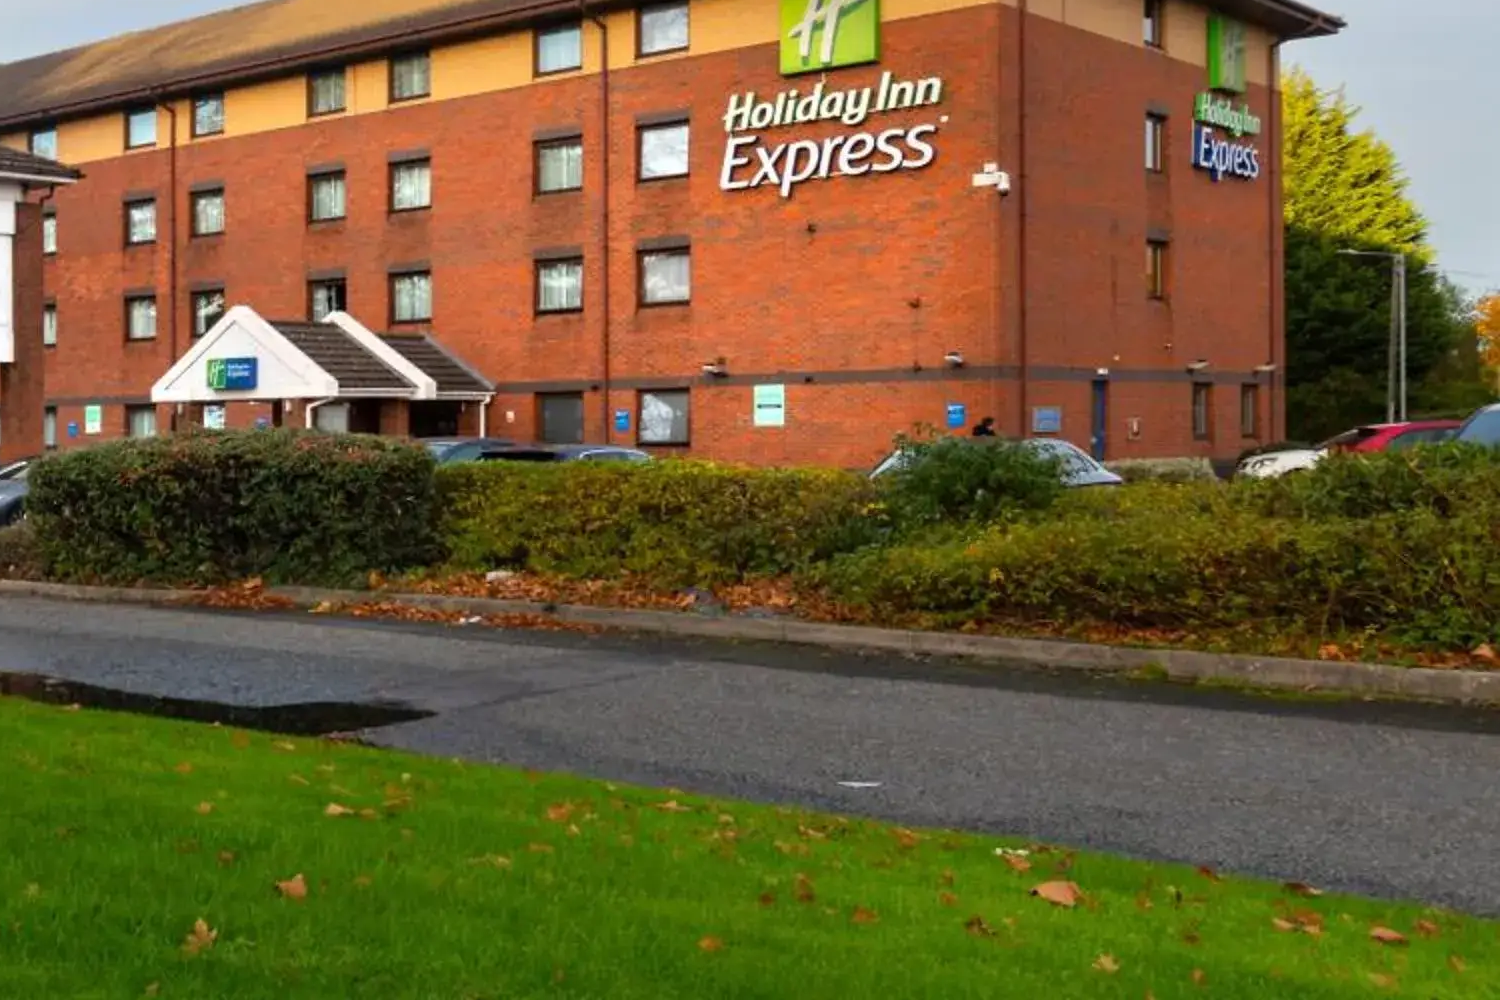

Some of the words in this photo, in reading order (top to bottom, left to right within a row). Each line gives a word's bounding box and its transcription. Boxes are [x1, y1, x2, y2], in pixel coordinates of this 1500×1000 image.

[722, 82, 871, 132] Holiday
[876, 71, 942, 112] Inn
[1200, 92, 1243, 137] Holiday
[1243, 103, 1261, 134] Inn
[720, 123, 936, 197] Express
[1200, 127, 1259, 181] Express
